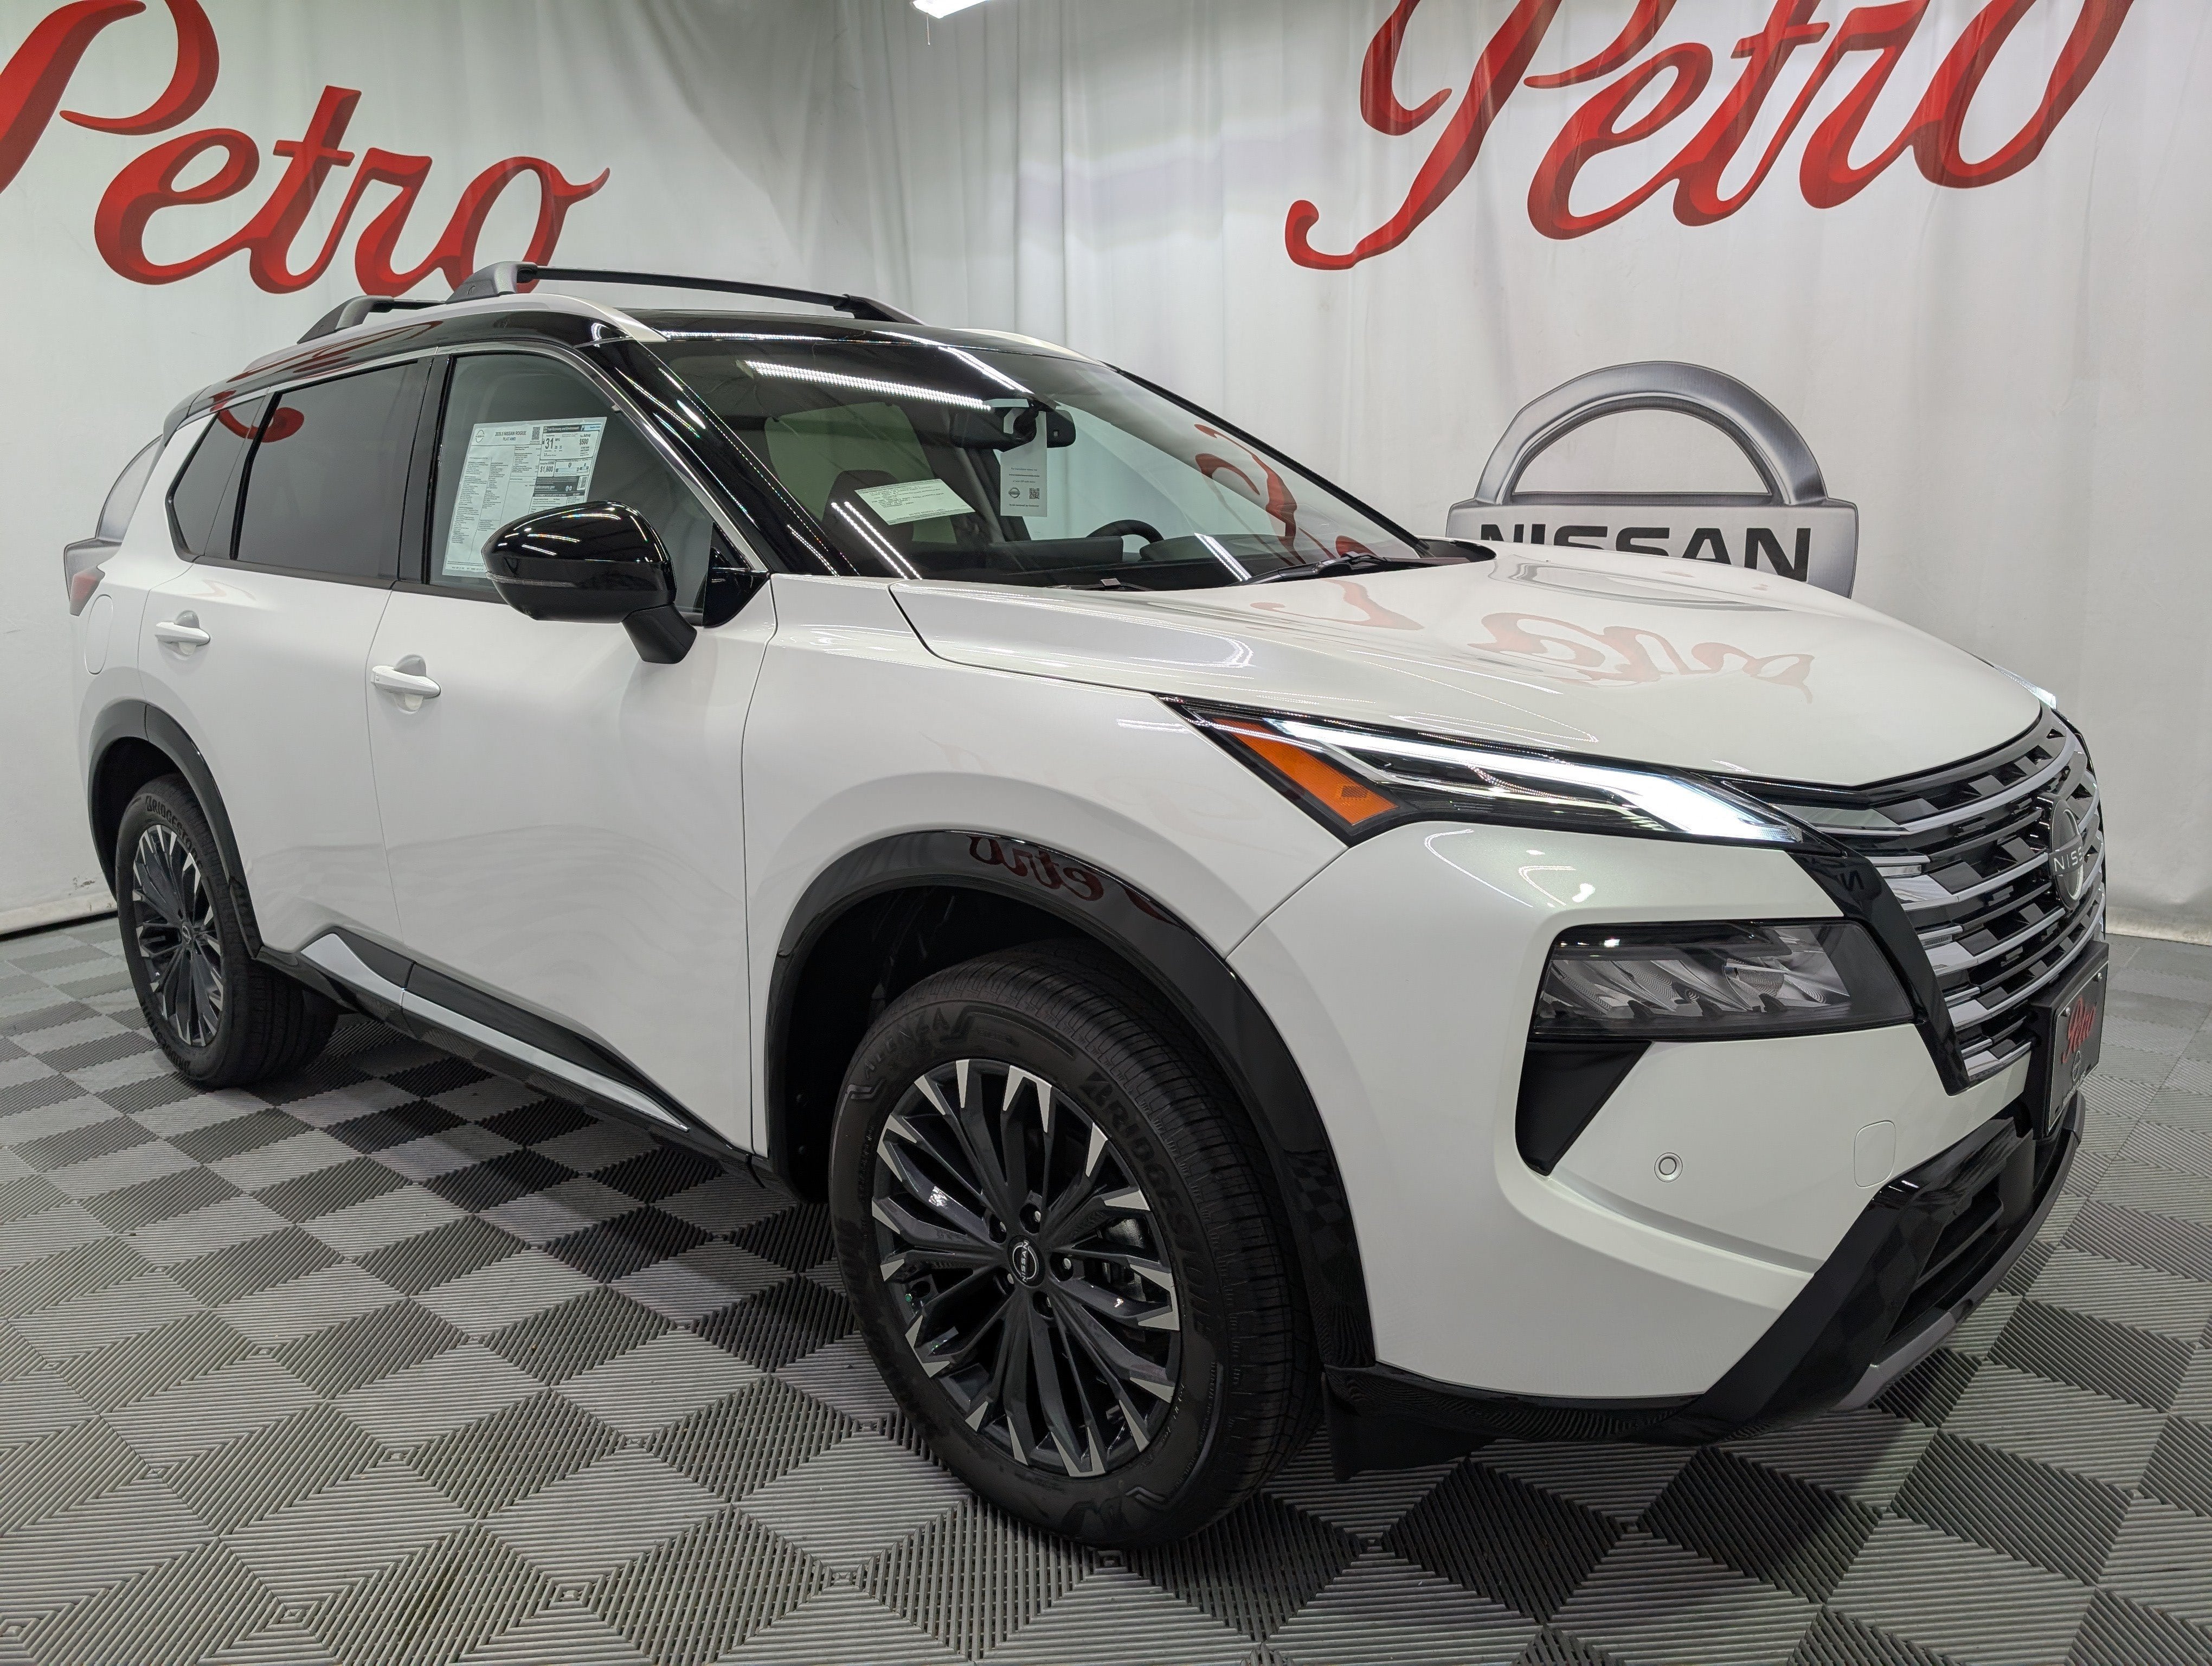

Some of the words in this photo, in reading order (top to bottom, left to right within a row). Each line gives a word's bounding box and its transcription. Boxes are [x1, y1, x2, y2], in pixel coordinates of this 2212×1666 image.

[545, 437, 554, 450] 31
[2054, 846, 2083, 872] NISS
[1020, 1240, 1030, 1283] NISSAN
